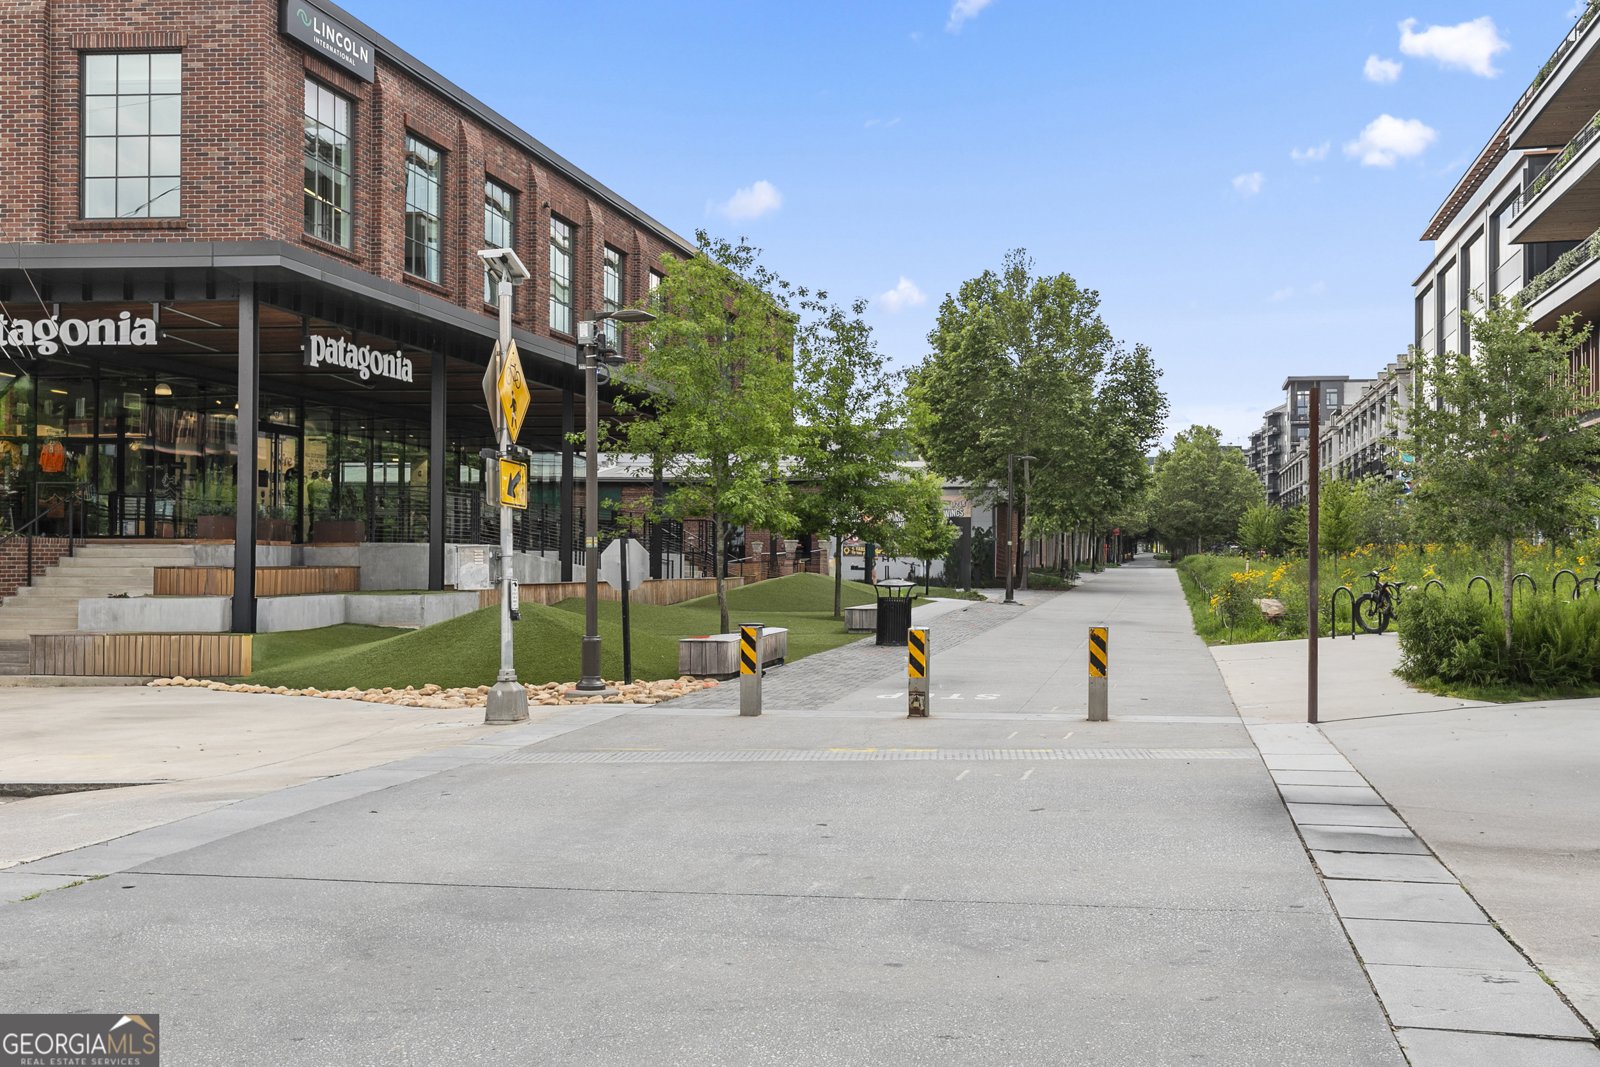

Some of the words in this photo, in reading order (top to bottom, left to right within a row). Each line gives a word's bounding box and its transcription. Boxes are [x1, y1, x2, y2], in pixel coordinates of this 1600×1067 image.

[313, 17, 368, 63] LINCOLN
[313, 36, 356, 66] INTERNATIONAL
[309, 334, 414, 383] patagonia
[876, 692, 1001, 700] STP
